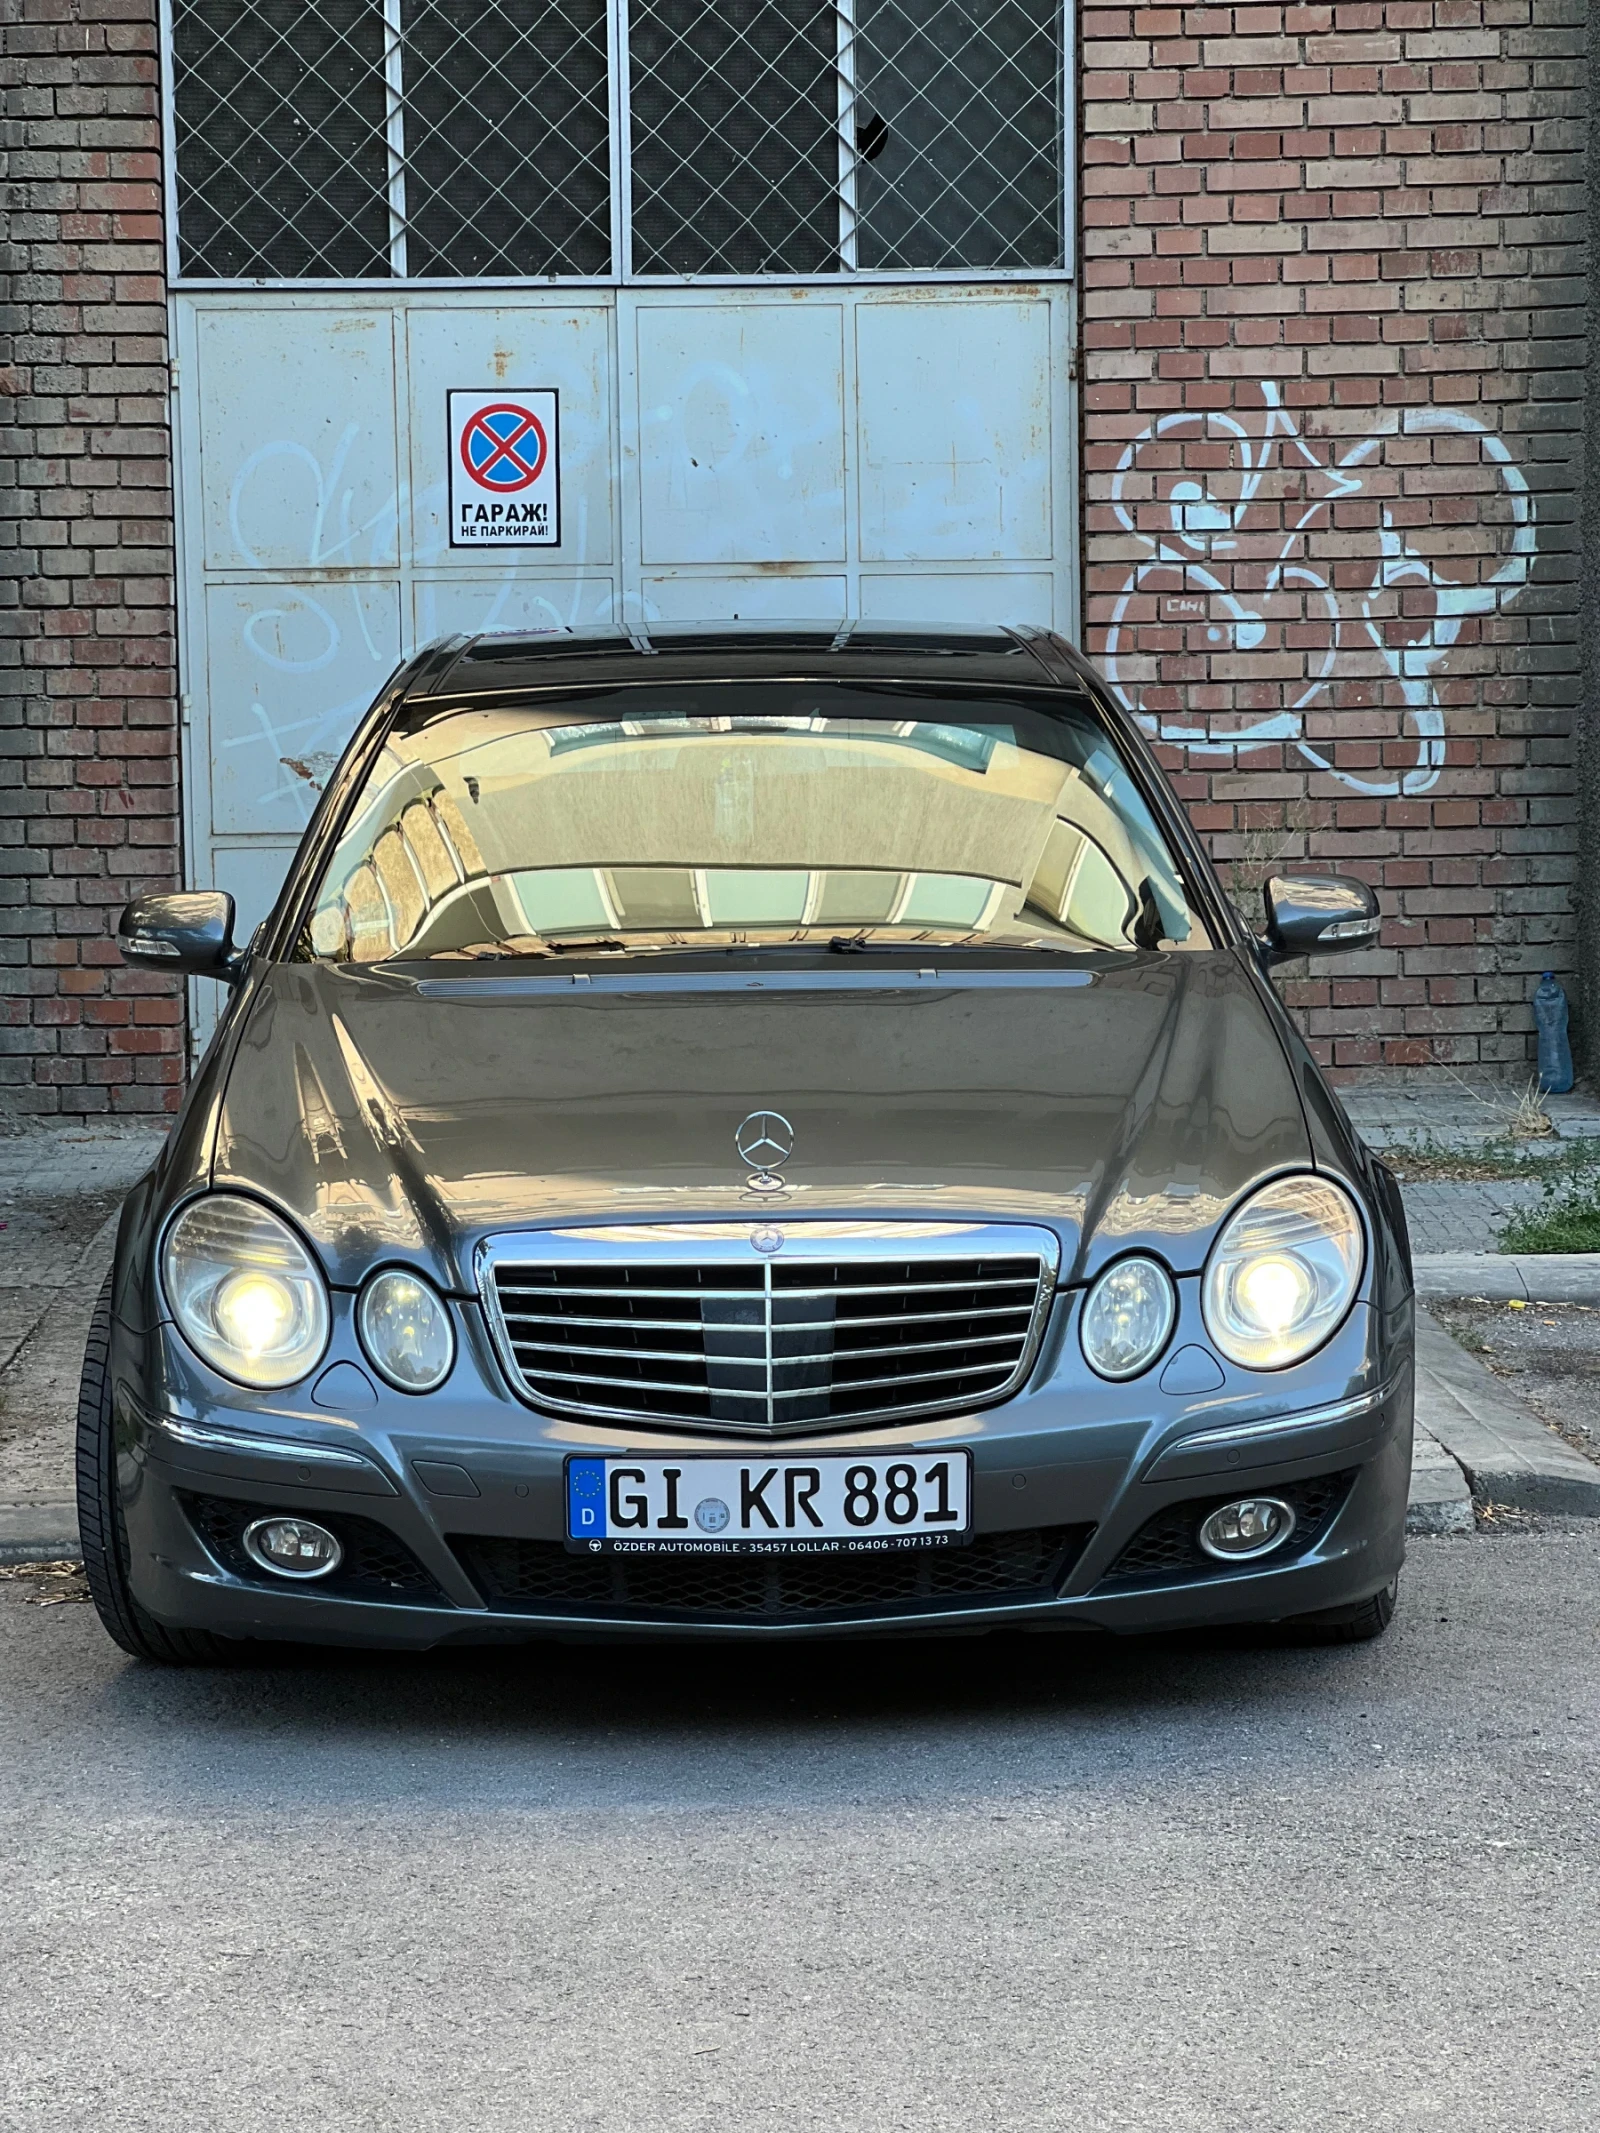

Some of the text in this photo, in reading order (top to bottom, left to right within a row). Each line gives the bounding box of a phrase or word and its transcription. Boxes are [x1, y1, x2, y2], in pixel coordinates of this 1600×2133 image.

[461, 503, 548, 522] ГАРАЖ!
[461, 522, 548, 536] НЕ ПАРКИРАЙ!
[610, 1468, 689, 1529] GI
[740, 1467, 824, 1529] KR
[843, 1462, 958, 1527] 881
[581, 1508, 595, 1525] D
[613, 1540, 656, 1552] ÖZDER
[749, 1543, 787, 1553] 35457
[790, 1542, 840, 1552] LOLLAR
[848, 1539, 889, 1551] 06406
[895, 1537, 917, 1548] 707
[920, 1536, 932, 1546] 13
[934, 1535, 949, 1545] 73
